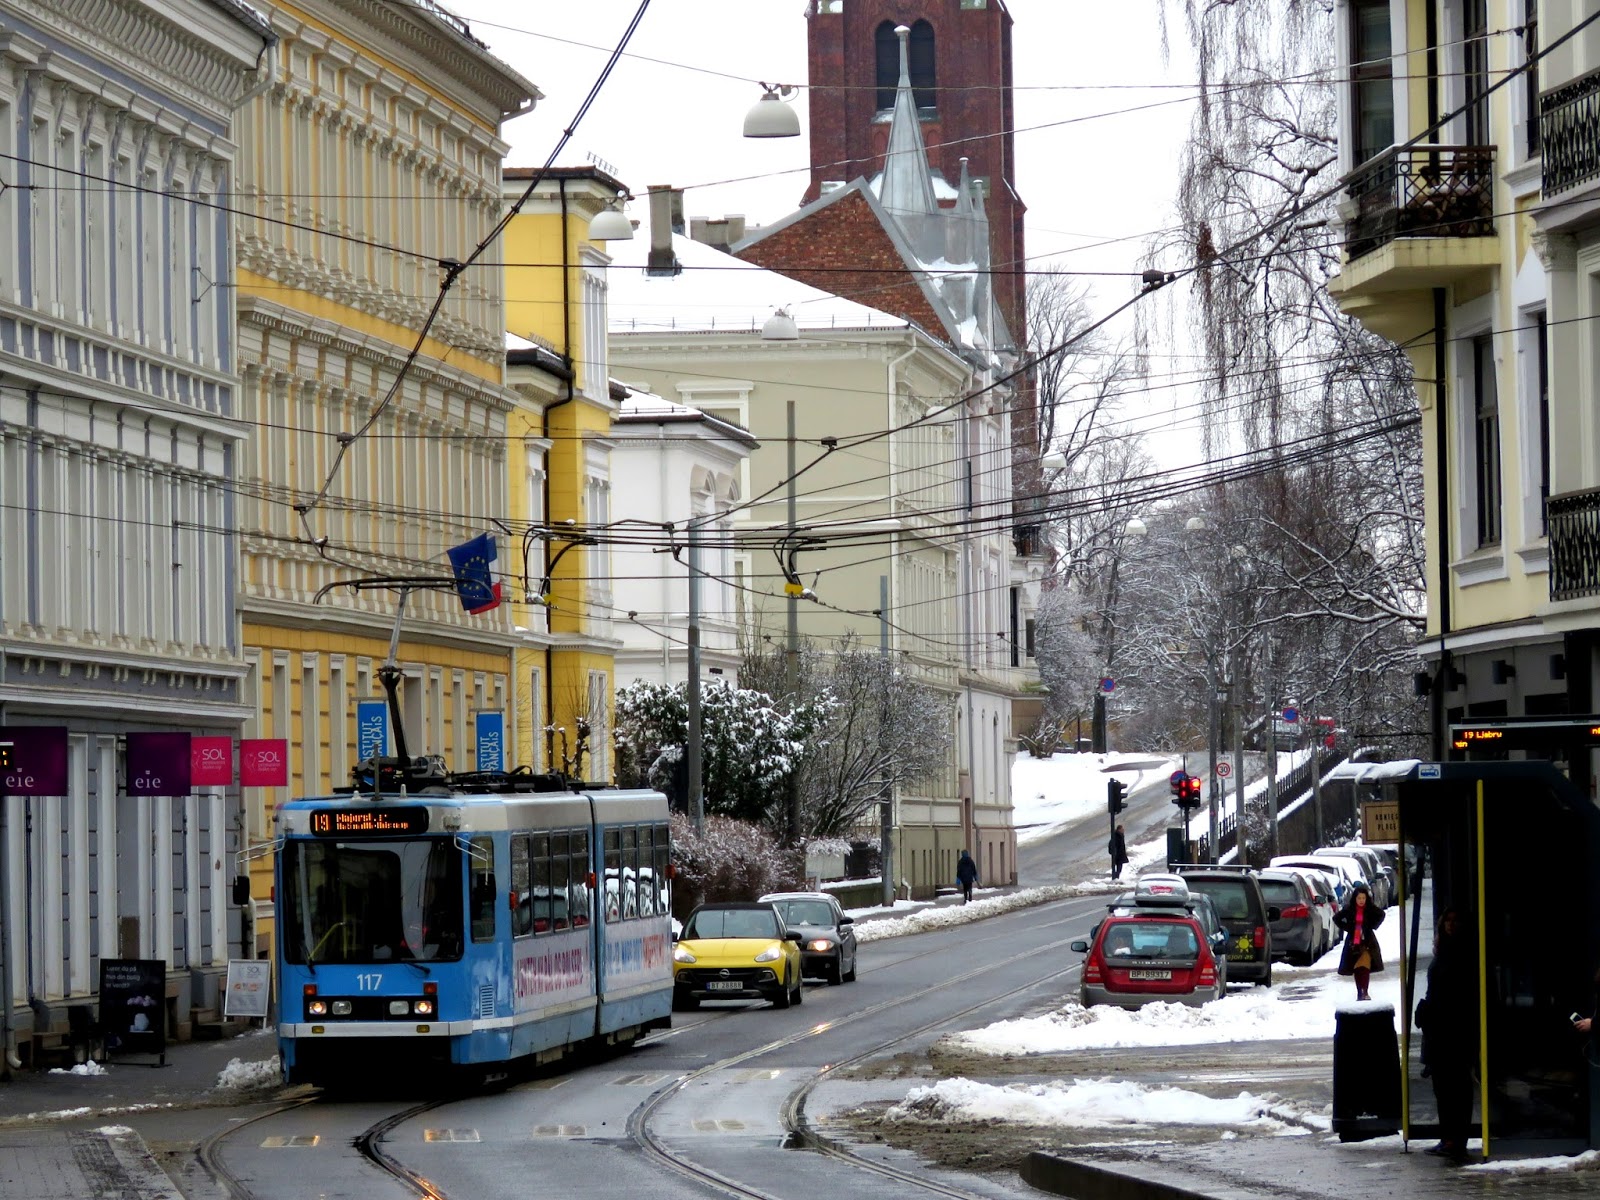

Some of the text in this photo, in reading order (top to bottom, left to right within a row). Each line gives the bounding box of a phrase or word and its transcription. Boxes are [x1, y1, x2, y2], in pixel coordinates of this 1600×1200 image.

[1463, 730, 1502, 739] 19 Ljabru
[361, 721, 374, 763] NSTITUT
[202, 748, 225, 760] SOL
[257, 751, 280, 763] SOL
[1219, 765, 1229, 774] 30
[5, 773, 35, 788] eie
[135, 775, 161, 789] eie
[246, 966, 261, 974] SOL
[1131, 970, 1142, 978] BP
[356, 974, 383, 991] 117
